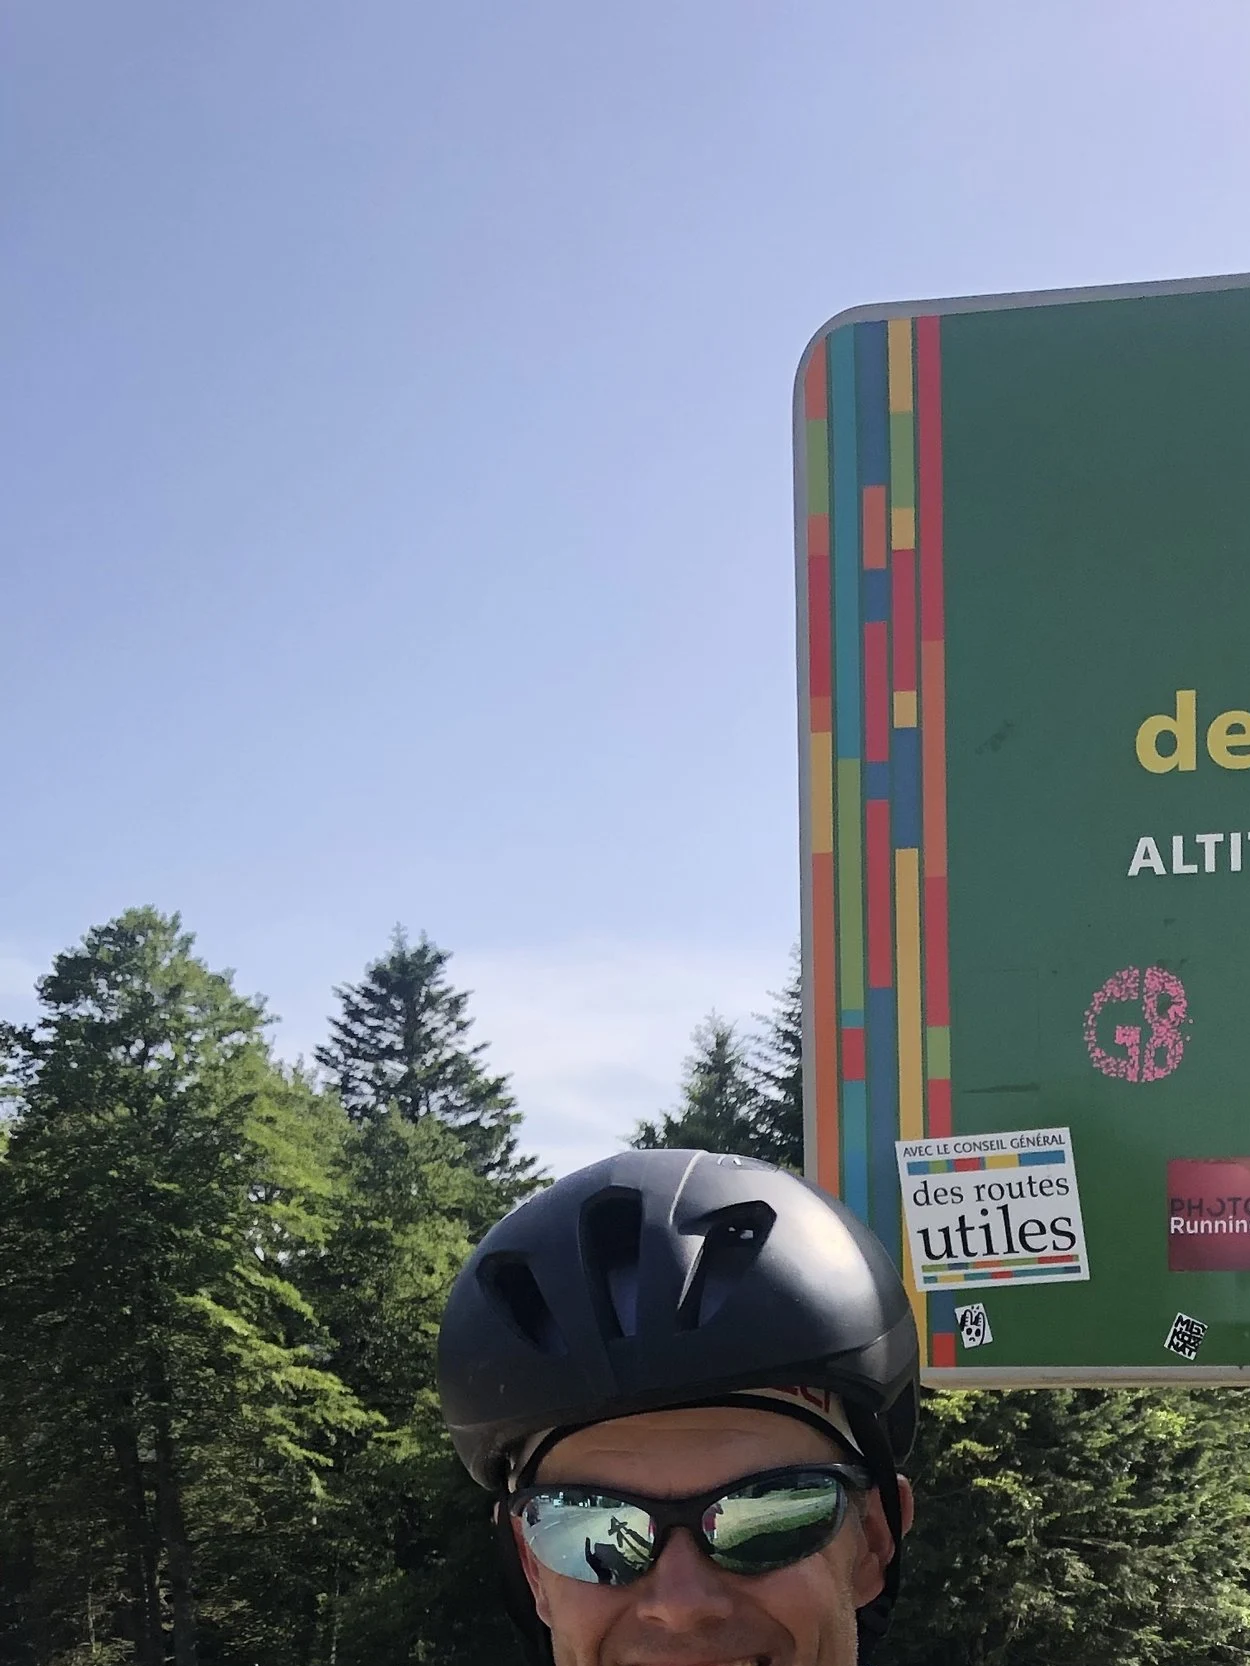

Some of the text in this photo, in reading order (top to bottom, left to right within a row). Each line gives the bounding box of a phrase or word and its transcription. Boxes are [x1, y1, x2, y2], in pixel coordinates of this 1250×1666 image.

[903, 1133, 1066, 1158] AVEC LE CONSEIL GÉNÉRAL
[913, 1175, 1070, 1206] des routes
[917, 1203, 1077, 1261] utiles
